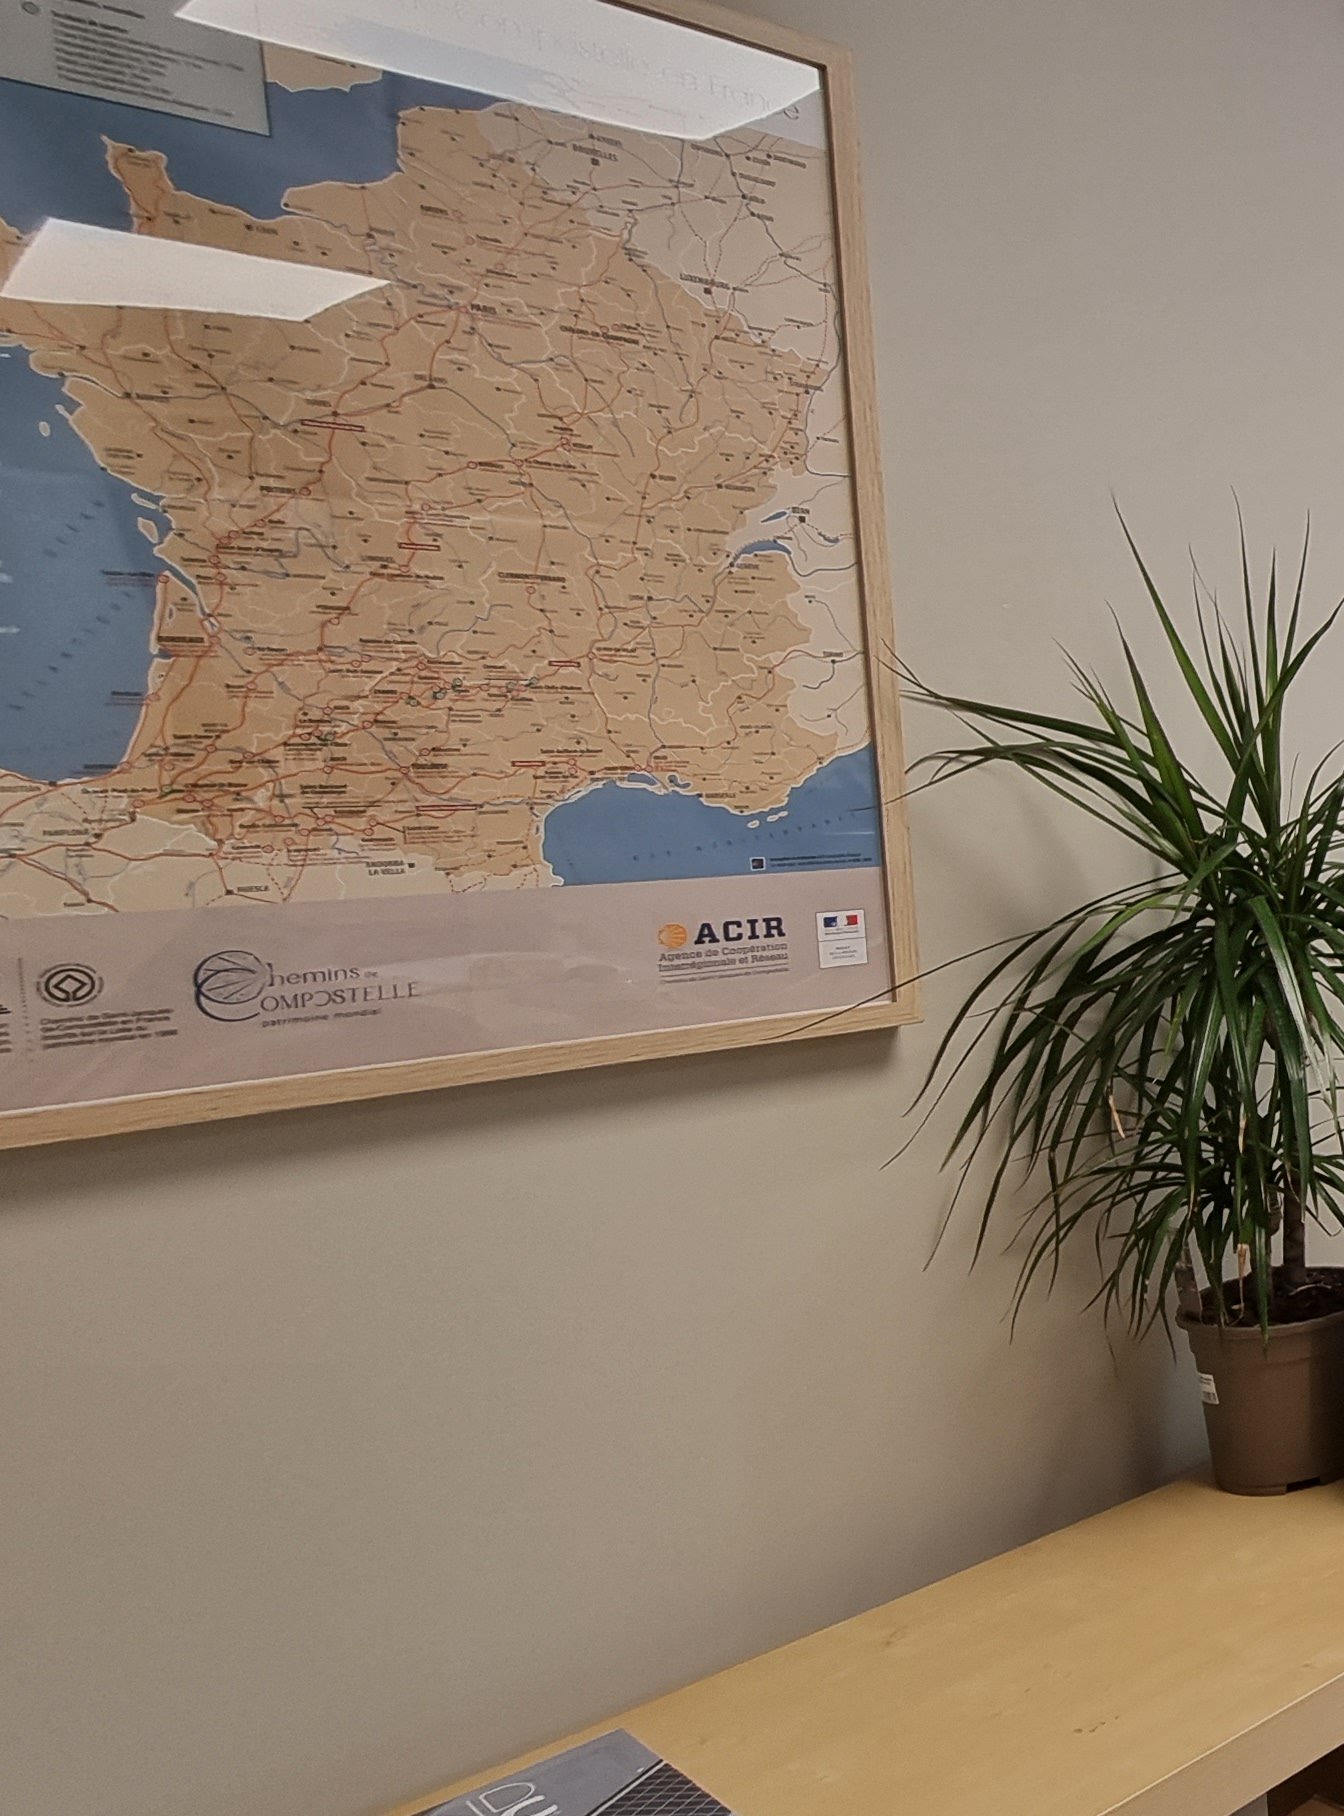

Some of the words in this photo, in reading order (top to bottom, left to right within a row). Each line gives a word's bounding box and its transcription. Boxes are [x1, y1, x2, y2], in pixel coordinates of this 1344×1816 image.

[694, 916, 786, 945] ACIR
[658, 950, 702, 963] Agence
[704, 948, 719, 957] de
